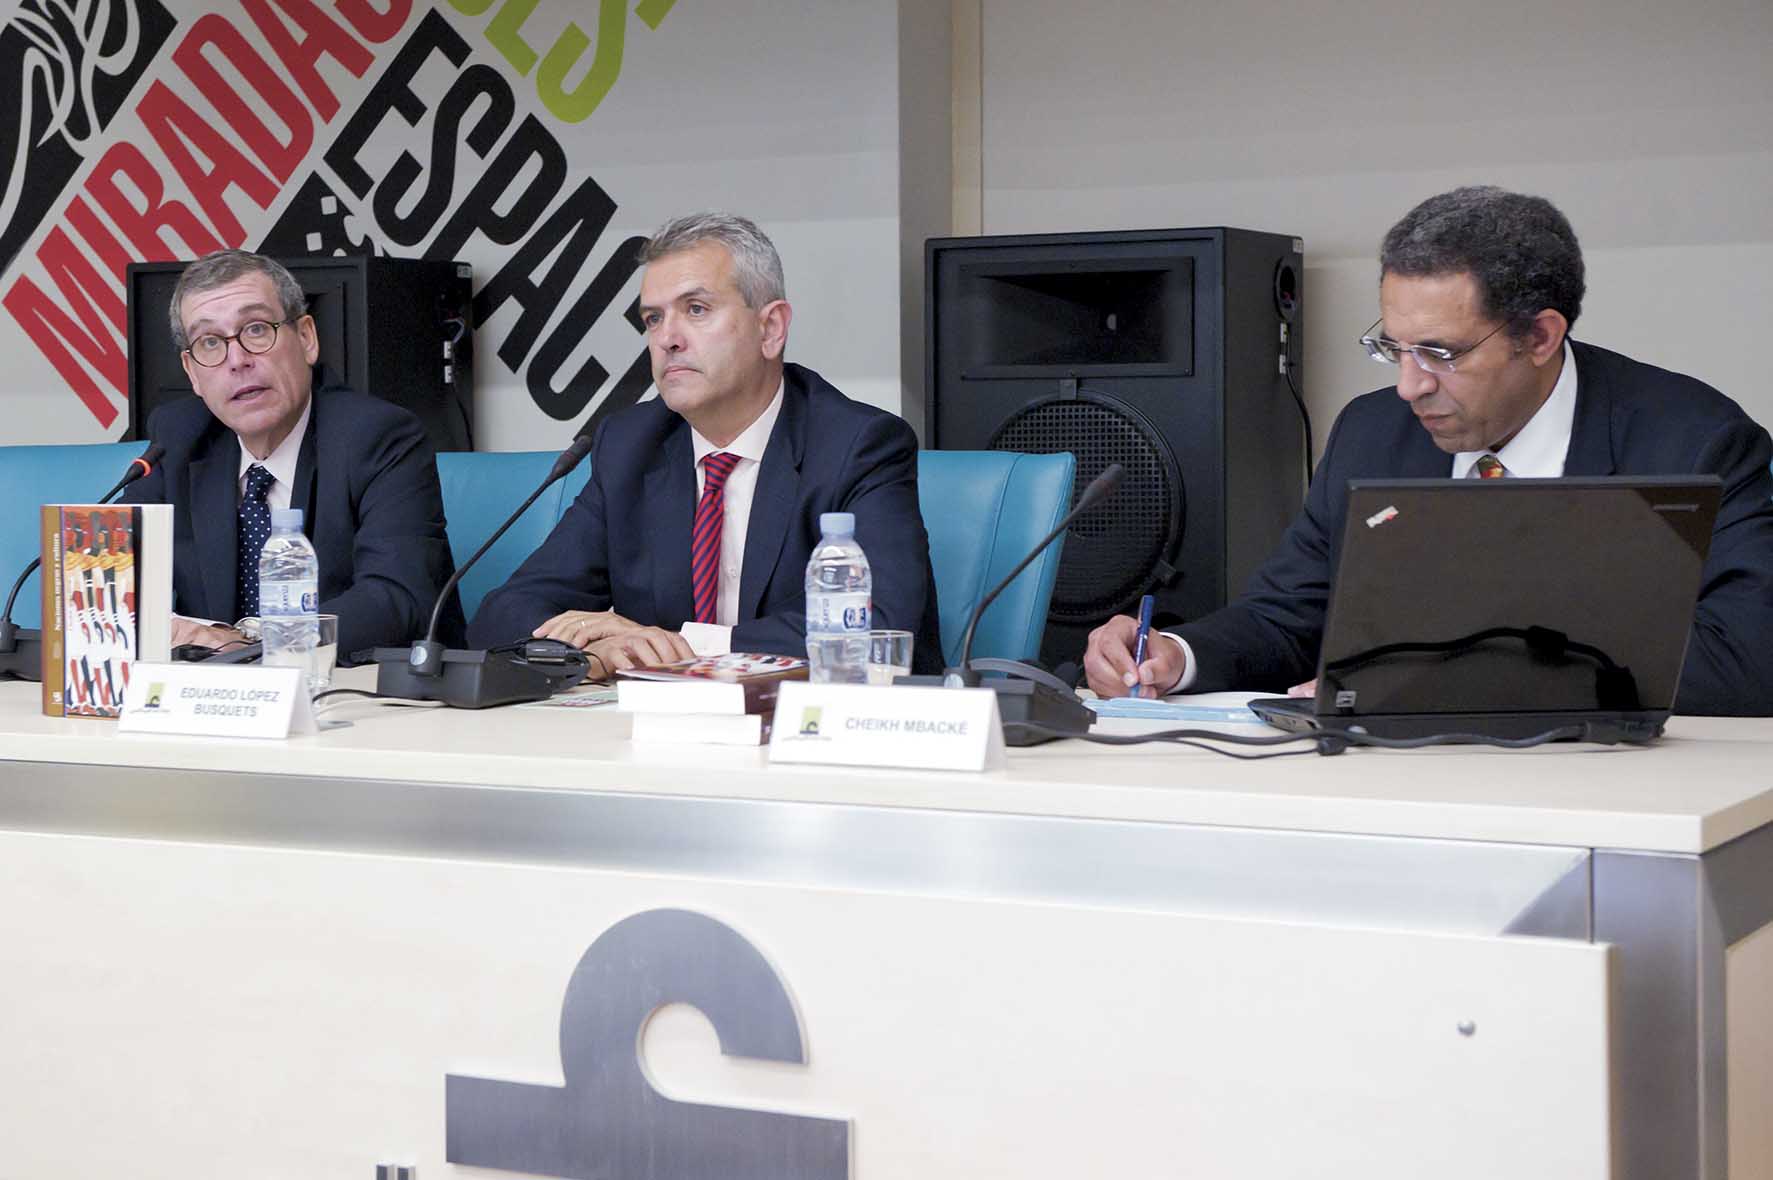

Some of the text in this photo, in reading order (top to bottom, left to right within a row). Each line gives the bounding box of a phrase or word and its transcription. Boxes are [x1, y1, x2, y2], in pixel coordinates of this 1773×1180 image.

[2, 0, 414, 430] MIRADA
[325, 8, 660, 440] ESPAC
[180, 687, 238, 700] EDUARDO
[193, 703, 257, 717] BUSQUETS
[845, 716, 900, 732] CHEIKH
